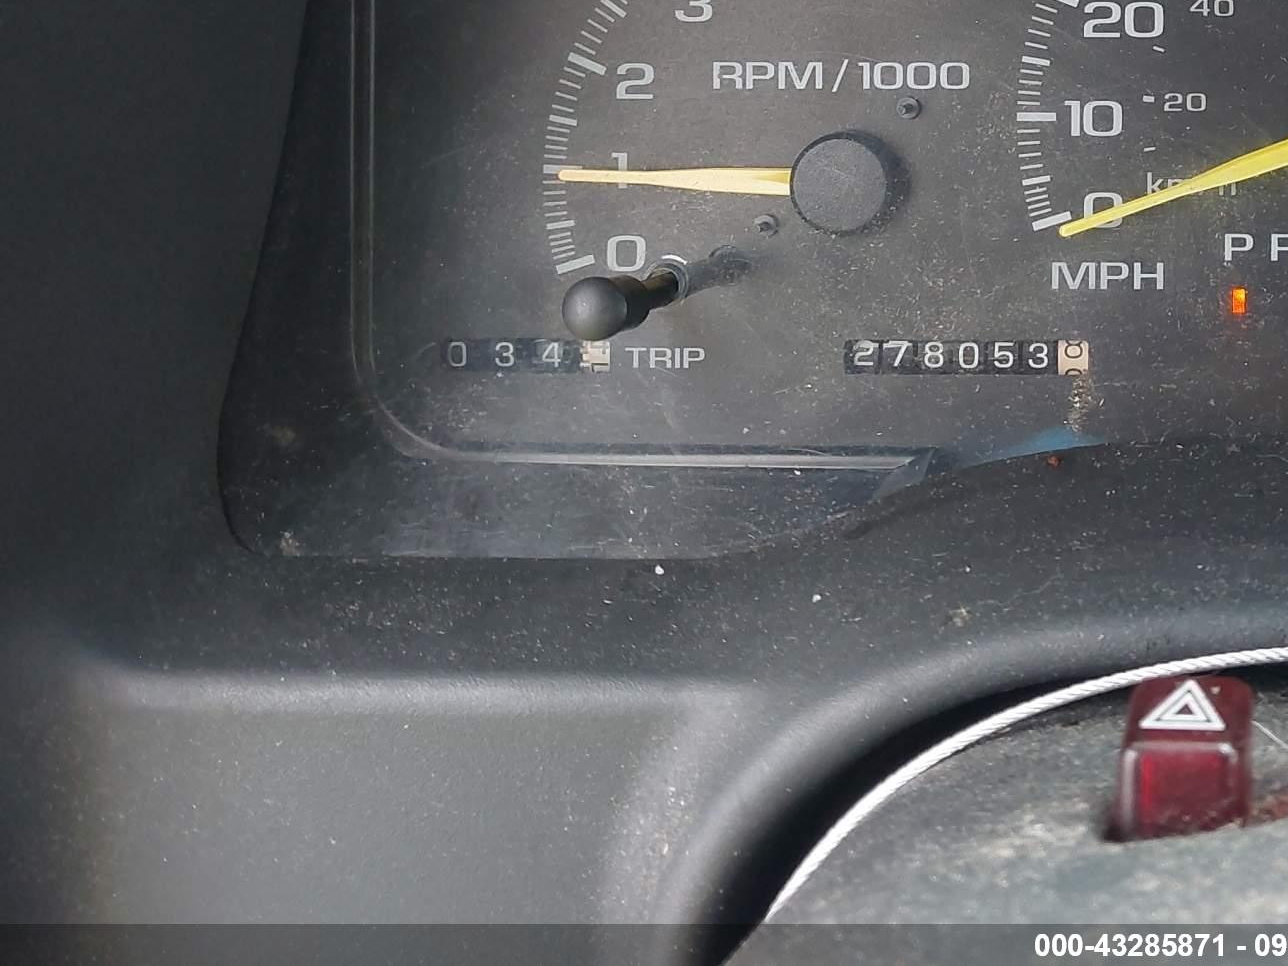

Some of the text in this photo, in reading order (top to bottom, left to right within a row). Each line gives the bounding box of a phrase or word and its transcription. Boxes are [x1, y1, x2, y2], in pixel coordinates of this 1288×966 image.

[1083, 1, 1164, 38] 20
[616, 62, 655, 100] 2
[1063, 100, 1123, 137] 10
[1163, 92, 1207, 112] 20
[611, 152, 628, 189] 1
[1083, 191, 1123, 229] 0
[606, 235, 647, 272] 0
[1223, 233, 1254, 261] P
[1051, 261, 1164, 290] MPH
[624, 347, 705, 369] TRIP
